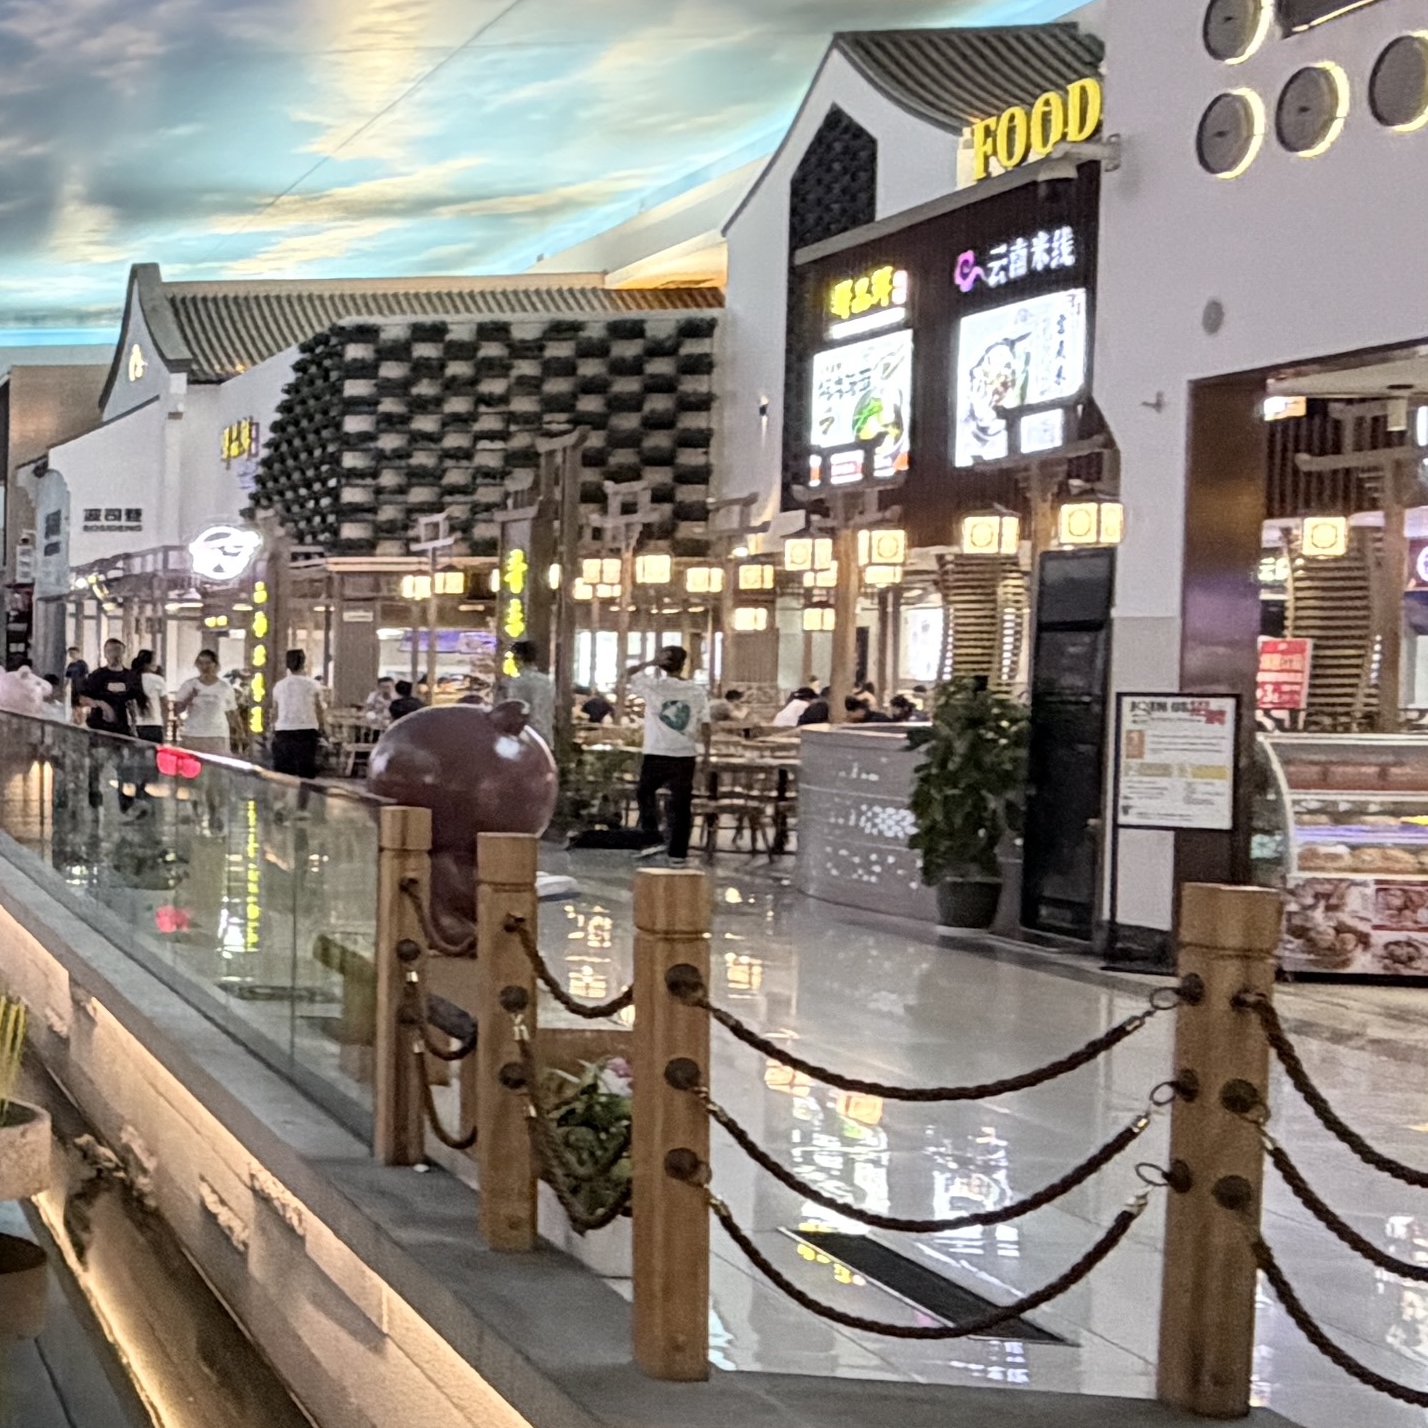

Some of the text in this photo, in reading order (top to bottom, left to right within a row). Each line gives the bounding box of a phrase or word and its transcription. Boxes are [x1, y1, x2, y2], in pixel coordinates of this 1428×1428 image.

[973, 77, 1101, 181] FOOD
[987, 226, 1076, 288] 云南米线
